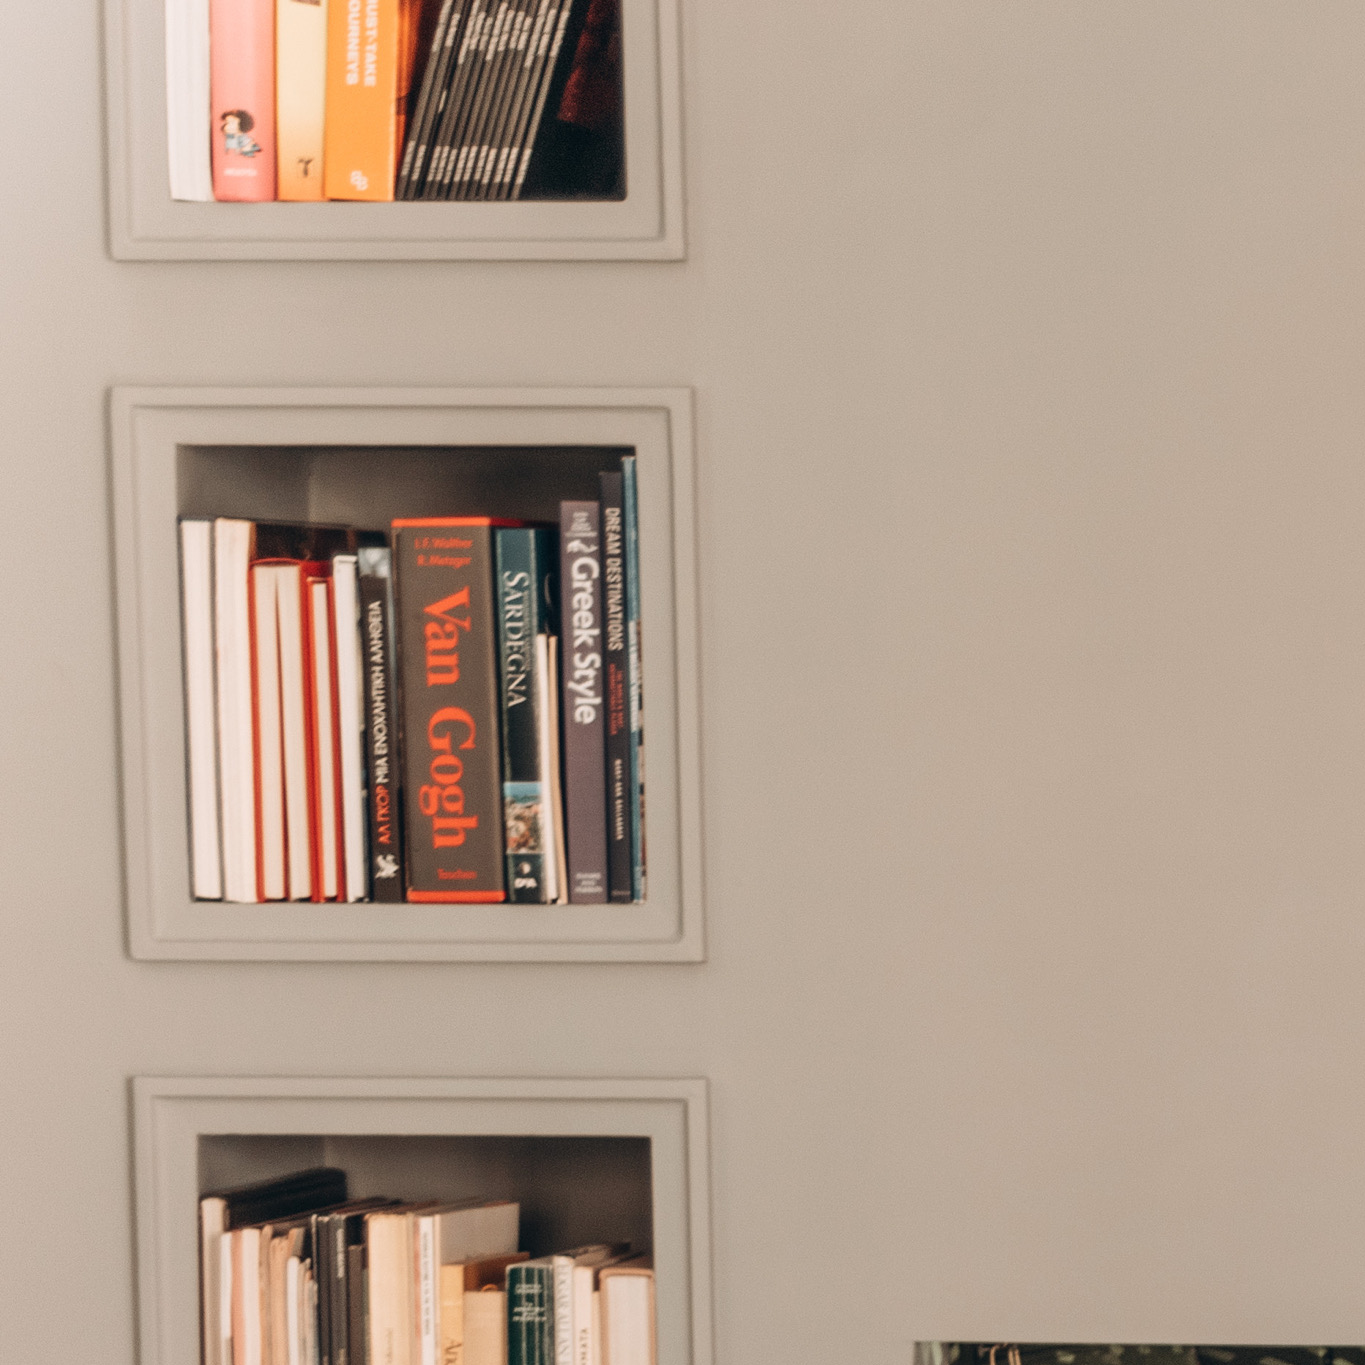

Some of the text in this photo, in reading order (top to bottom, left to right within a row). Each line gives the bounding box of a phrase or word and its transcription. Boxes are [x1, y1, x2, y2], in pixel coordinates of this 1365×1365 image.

[364, 0, 378, 87] UST-TAKE
[605, 507, 622, 554] DREAM
[503, 570, 530, 708] SARDEGNA
[571, 556, 600, 647] Greek
[606, 558, 624, 651] DESTINATIONS
[418, 585, 480, 850] Van Gogh
[567, 652, 602, 724] Style
